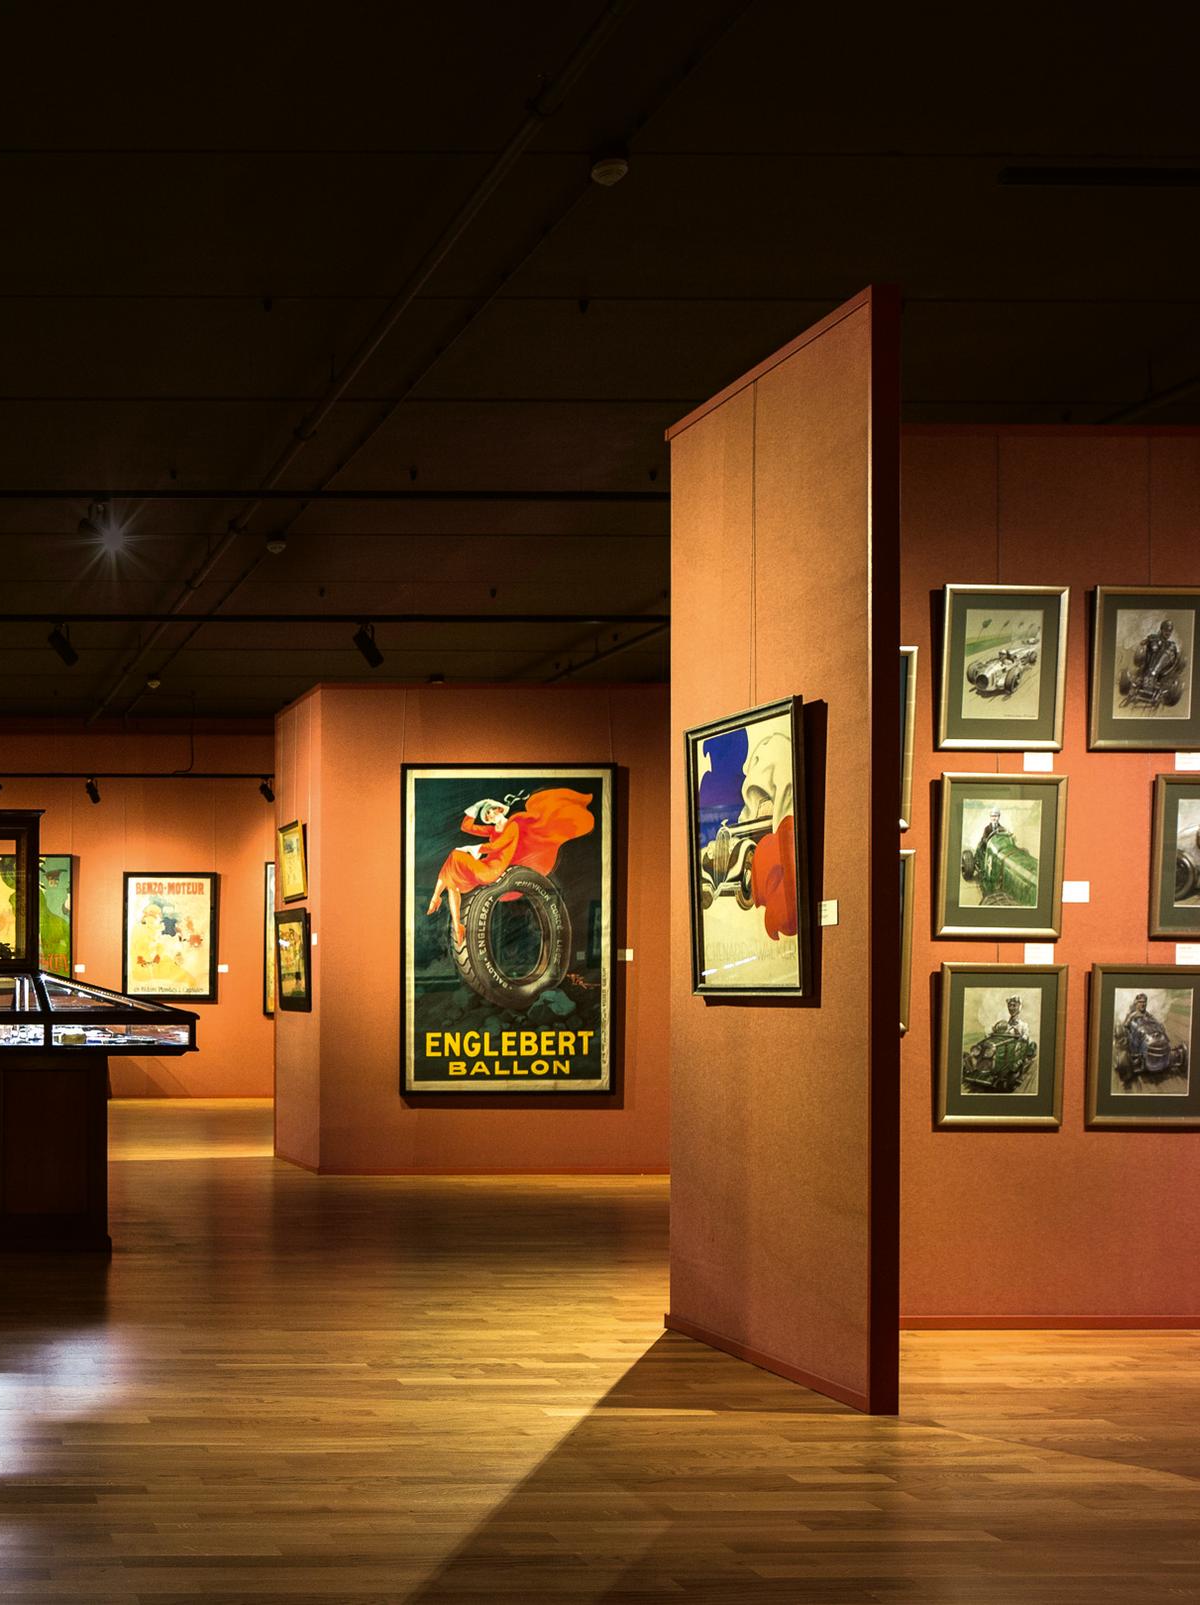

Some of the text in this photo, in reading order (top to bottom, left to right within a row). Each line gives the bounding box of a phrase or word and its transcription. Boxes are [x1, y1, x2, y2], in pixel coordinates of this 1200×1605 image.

[477, 895, 494, 956] ENGLEBERT
[425, 1030, 594, 1058] ENGLEBERT
[448, 1059, 571, 1076] BALLON
